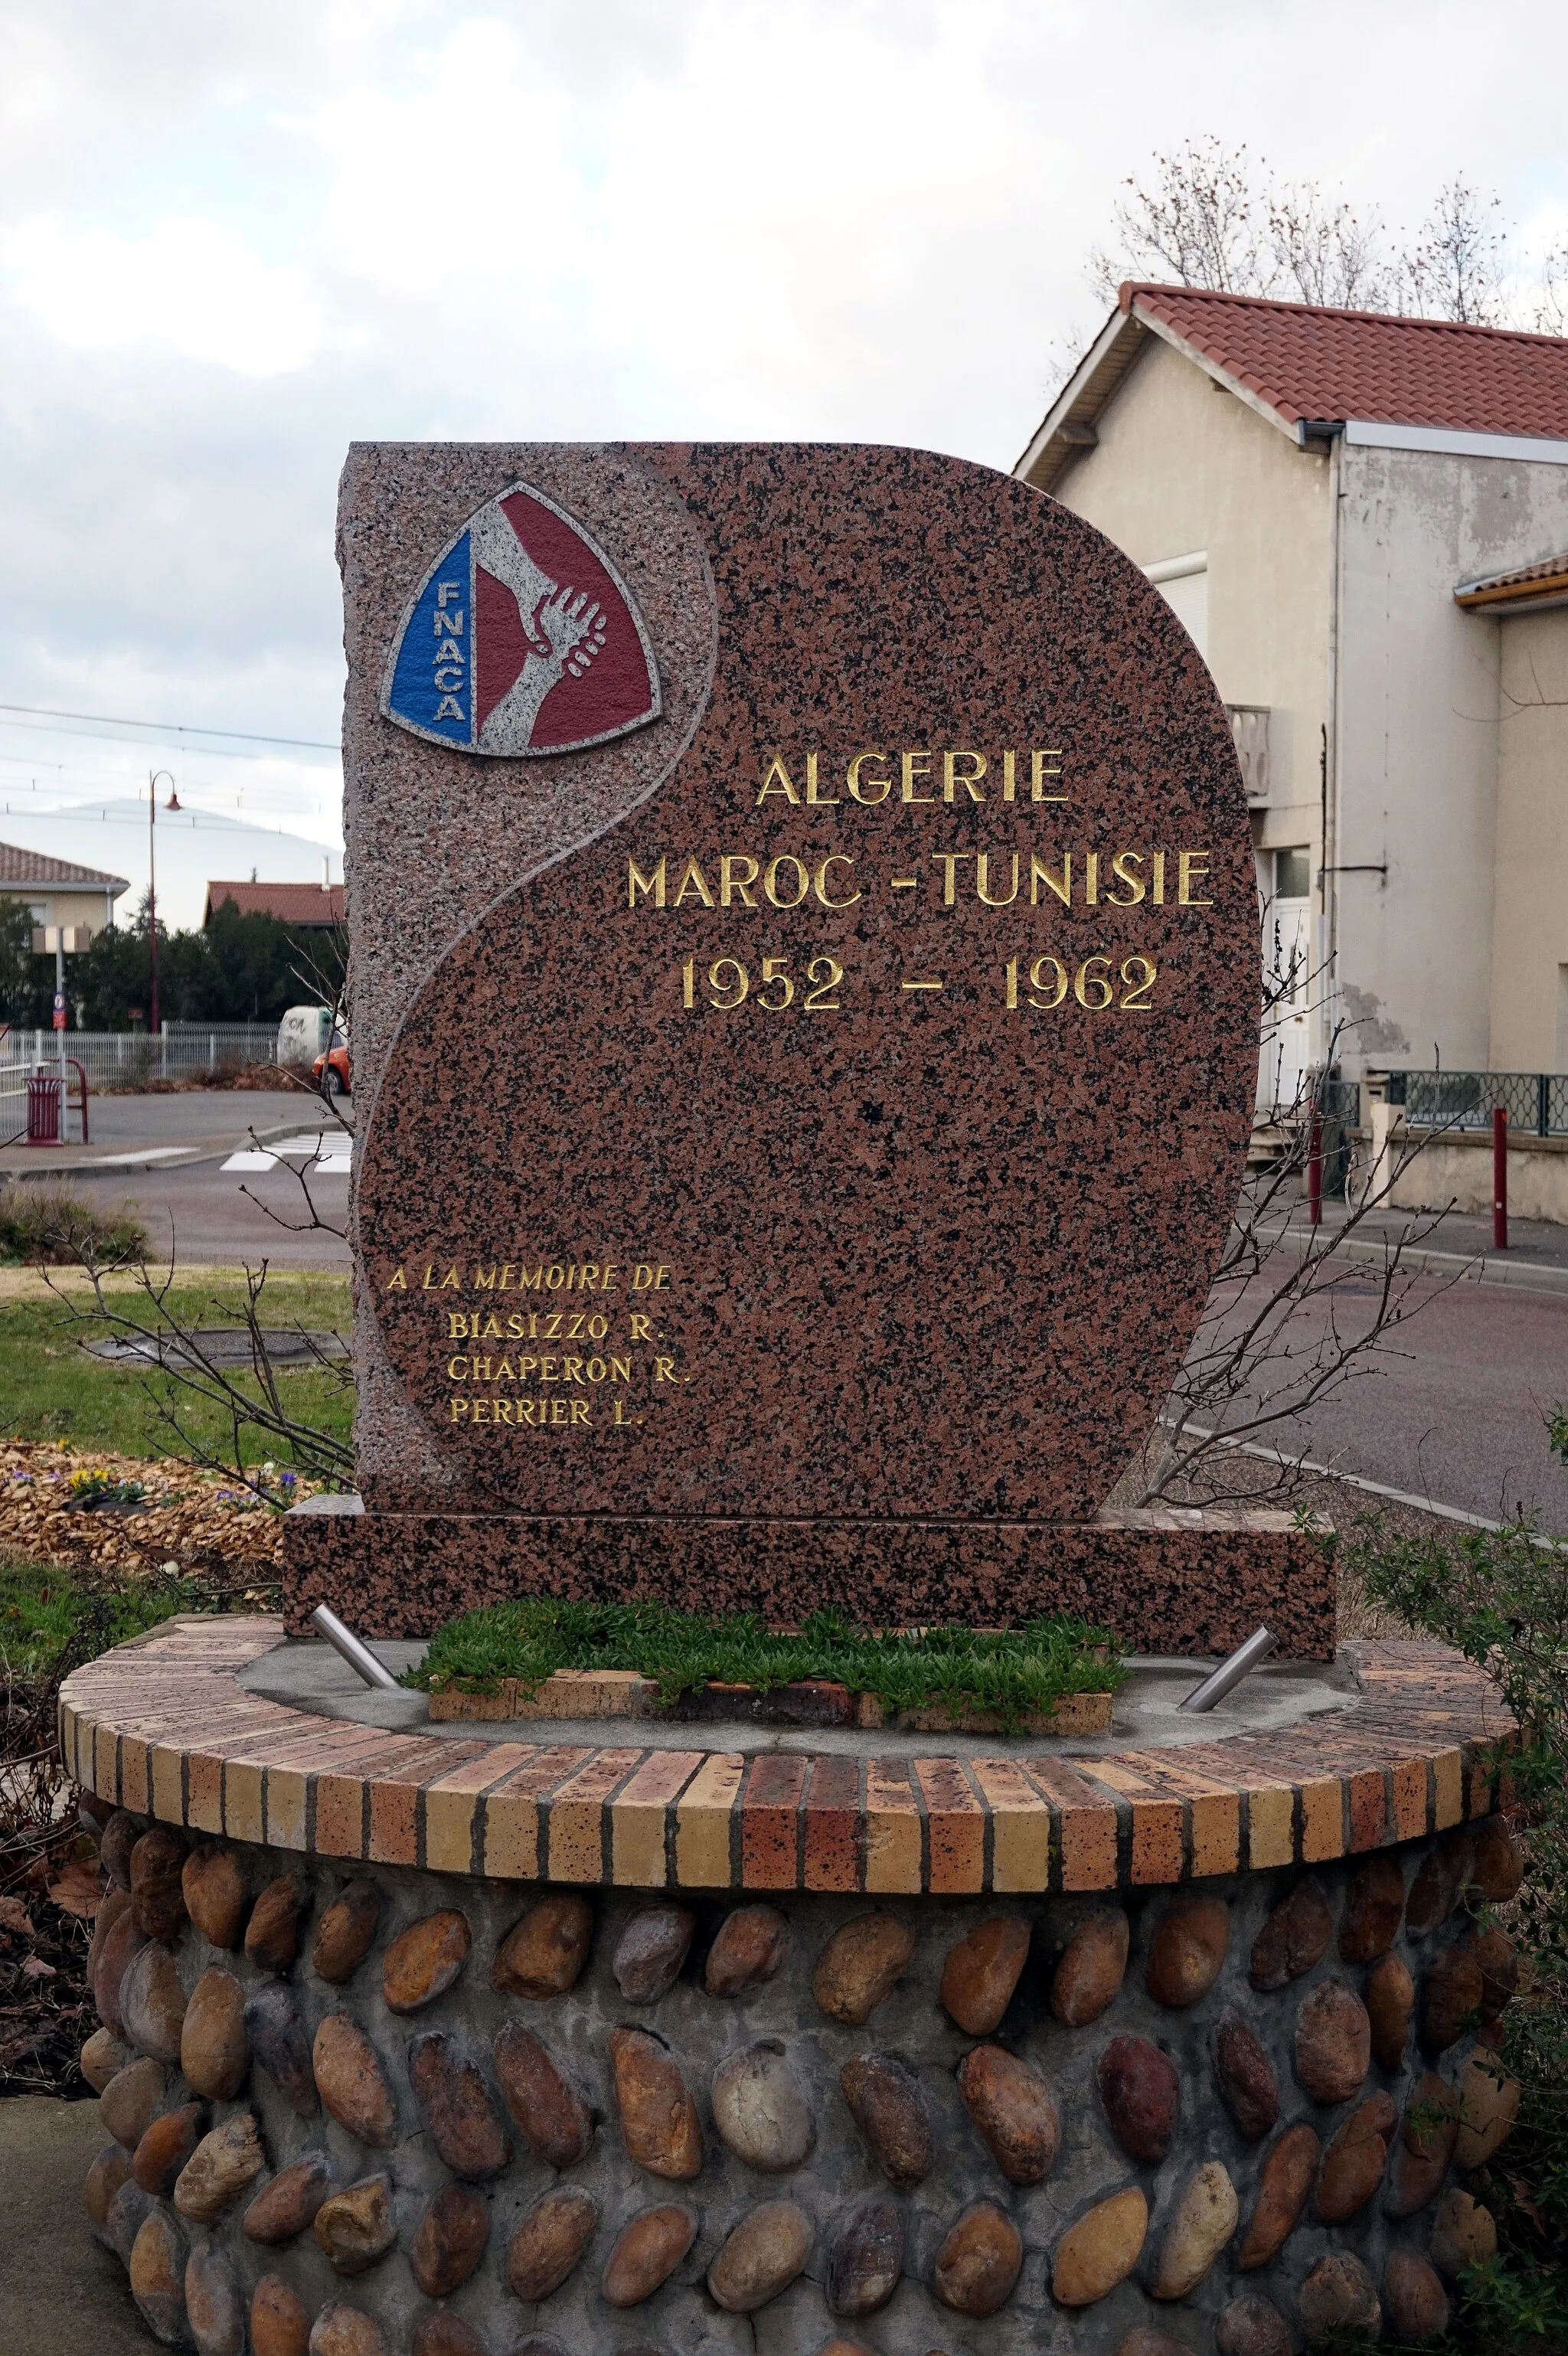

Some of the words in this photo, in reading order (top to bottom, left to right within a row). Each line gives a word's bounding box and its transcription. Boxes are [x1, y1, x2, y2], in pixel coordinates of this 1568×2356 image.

[432, 582, 466, 721] FNACA
[755, 748, 1070, 805] ALGERIE
[628, 854, 863, 908] MAROC
[932, 850, 1214, 908] TUNISIE
[682, 956, 844, 1011] 1952
[1005, 956, 1158, 1011] 1962
[387, 1263, 407, 1289] A
[423, 1263, 459, 1289] LA
[474, 1264, 618, 1289] MEMOIRE
[632, 1265, 671, 1290] DE
[448, 1312, 608, 1338] BIASIZZO
[629, 1313, 665, 1341] R.
[447, 1355, 632, 1385] CHAPERON
[449, 1398, 593, 1426] PERRIER
[614, 1400, 643, 1425] L.
